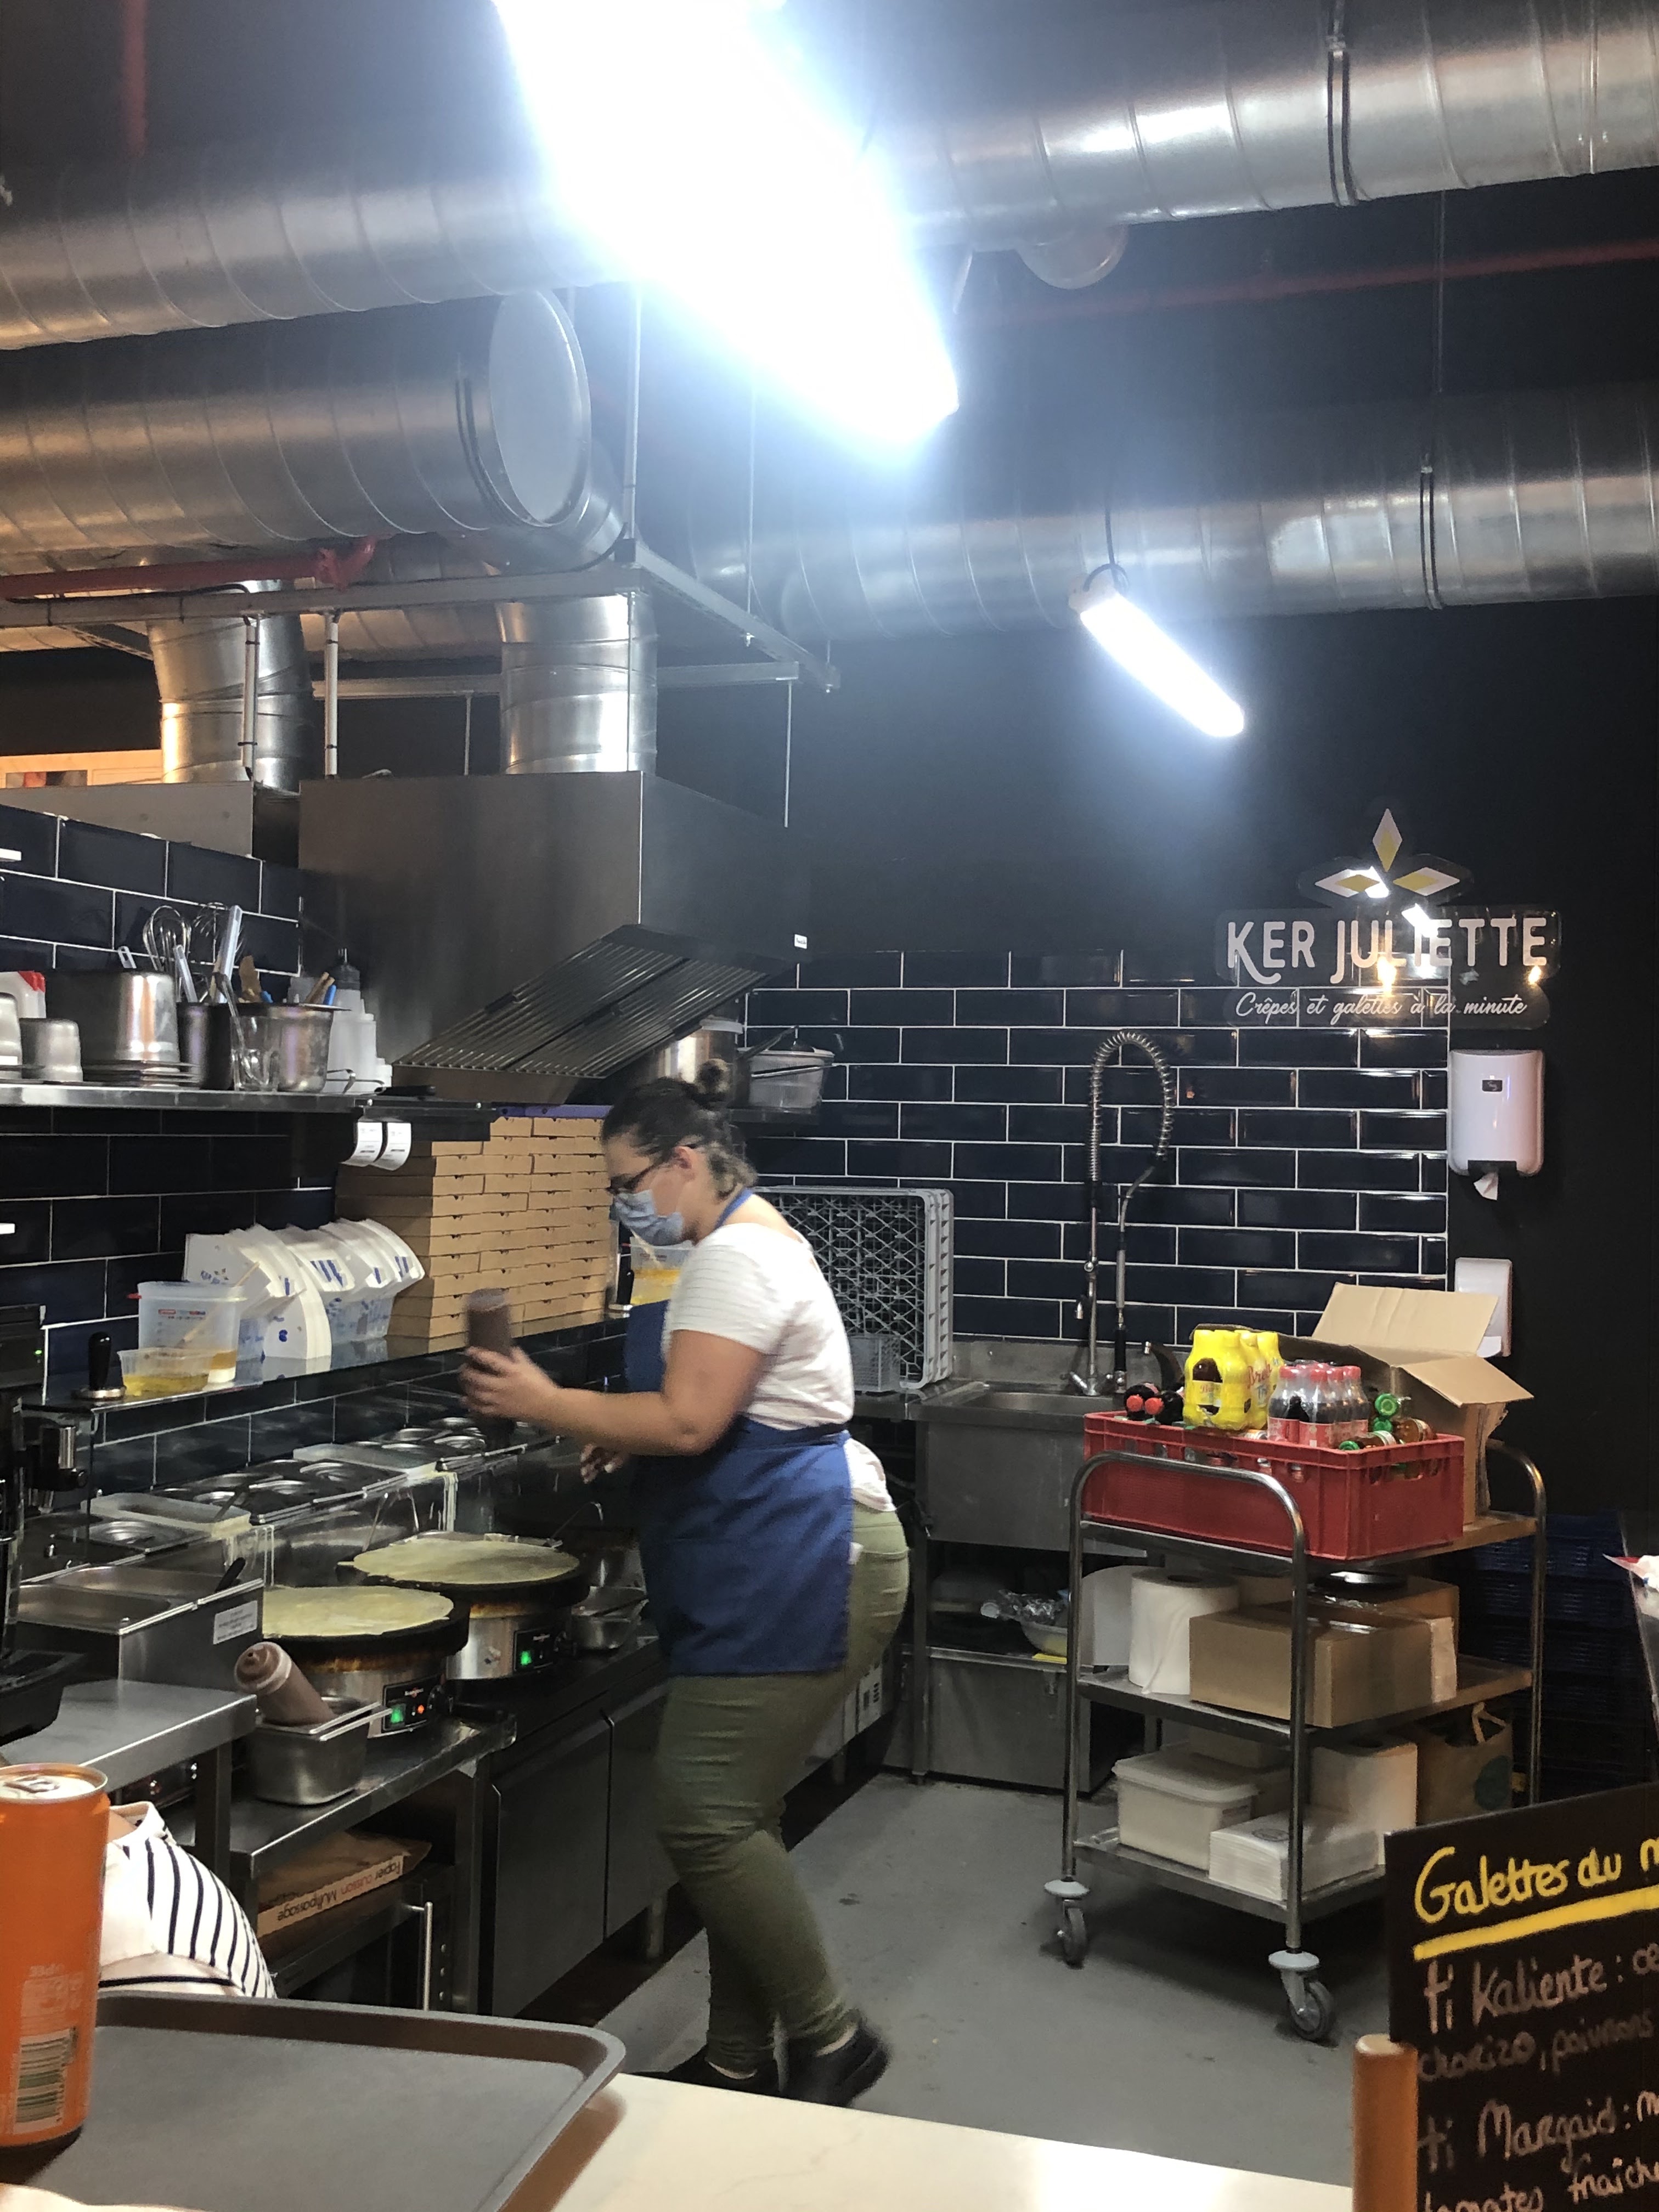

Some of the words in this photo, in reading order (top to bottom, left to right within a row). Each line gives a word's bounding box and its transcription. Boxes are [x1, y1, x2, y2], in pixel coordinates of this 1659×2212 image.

[1227, 921, 1315, 984] KER
[1330, 917, 1547, 984] JULIETTE
[1236, 992, 1297, 1024] Crêpes
[1306, 994, 1329, 1014] et
[1330, 993, 1402, 1025] galettes
[1410, 994, 1425, 1014] à
[1435, 993, 1457, 1014] la
[1463, 994, 1528, 1014] minute
[1414, 1846, 1570, 1923] Galettes
[1578, 1847, 1622, 1887] du
